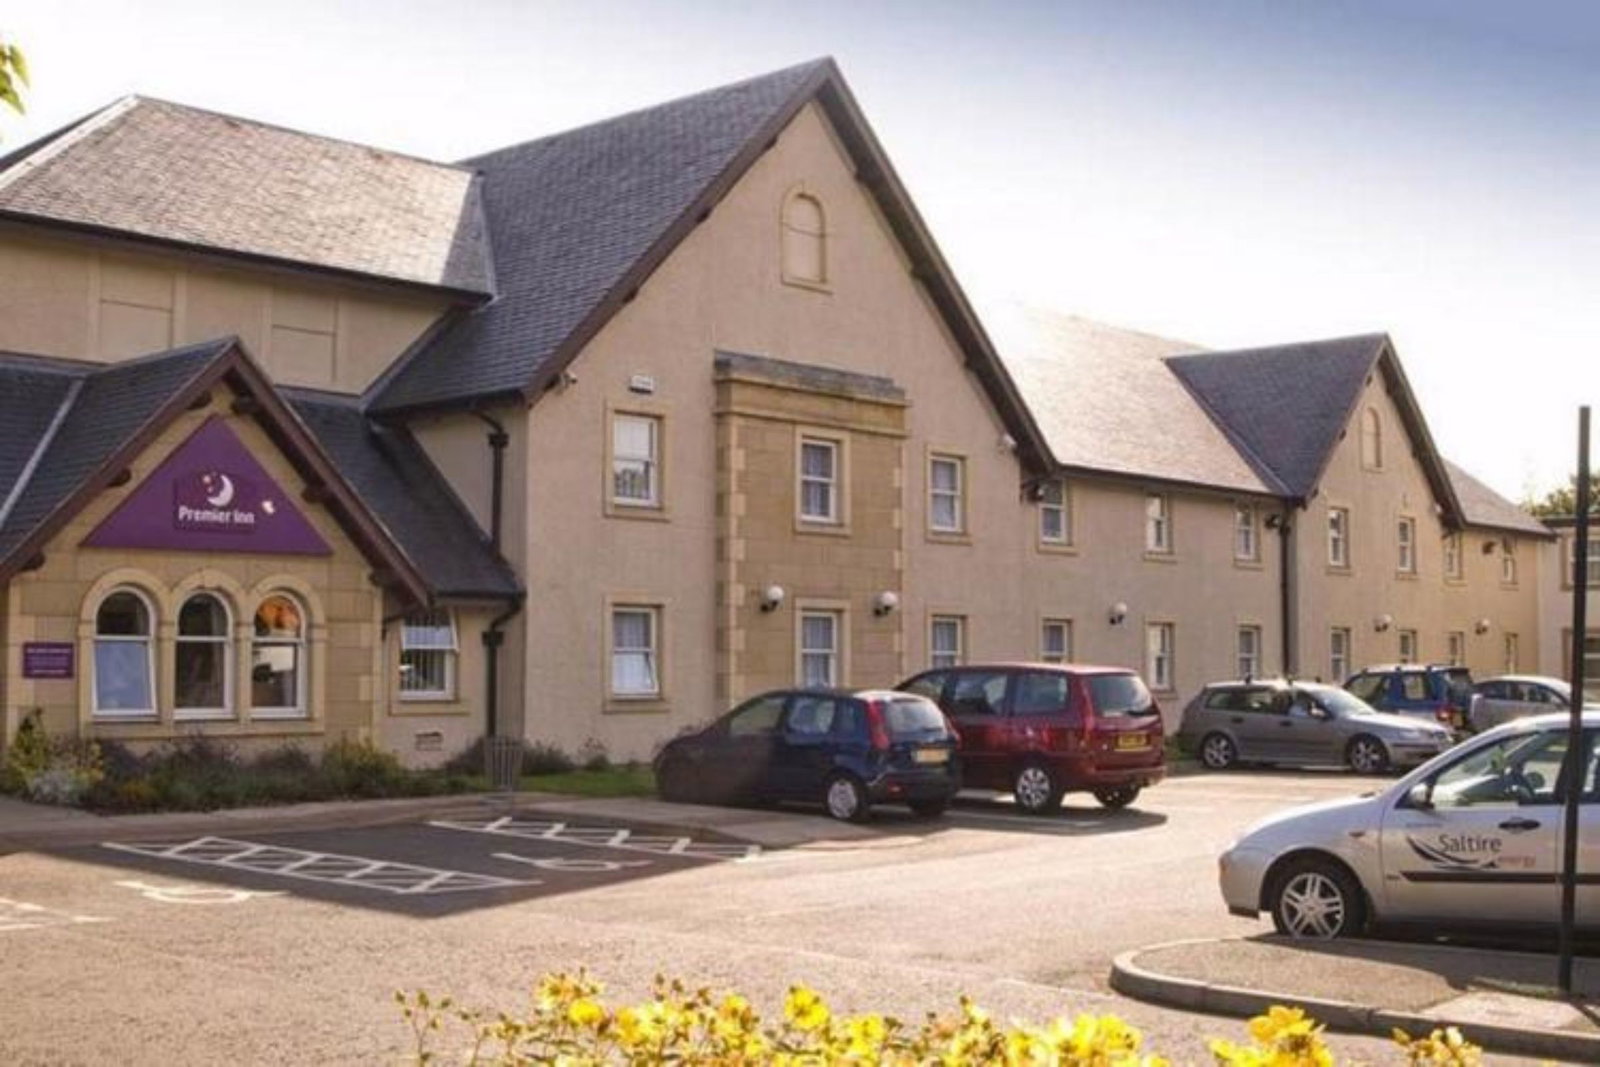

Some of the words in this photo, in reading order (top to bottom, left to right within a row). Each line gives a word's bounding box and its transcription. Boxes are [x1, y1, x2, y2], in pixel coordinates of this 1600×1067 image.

[178, 505, 231, 523] Premier
[234, 509, 255, 523] Inn
[1439, 833, 1503, 852] Saltire
